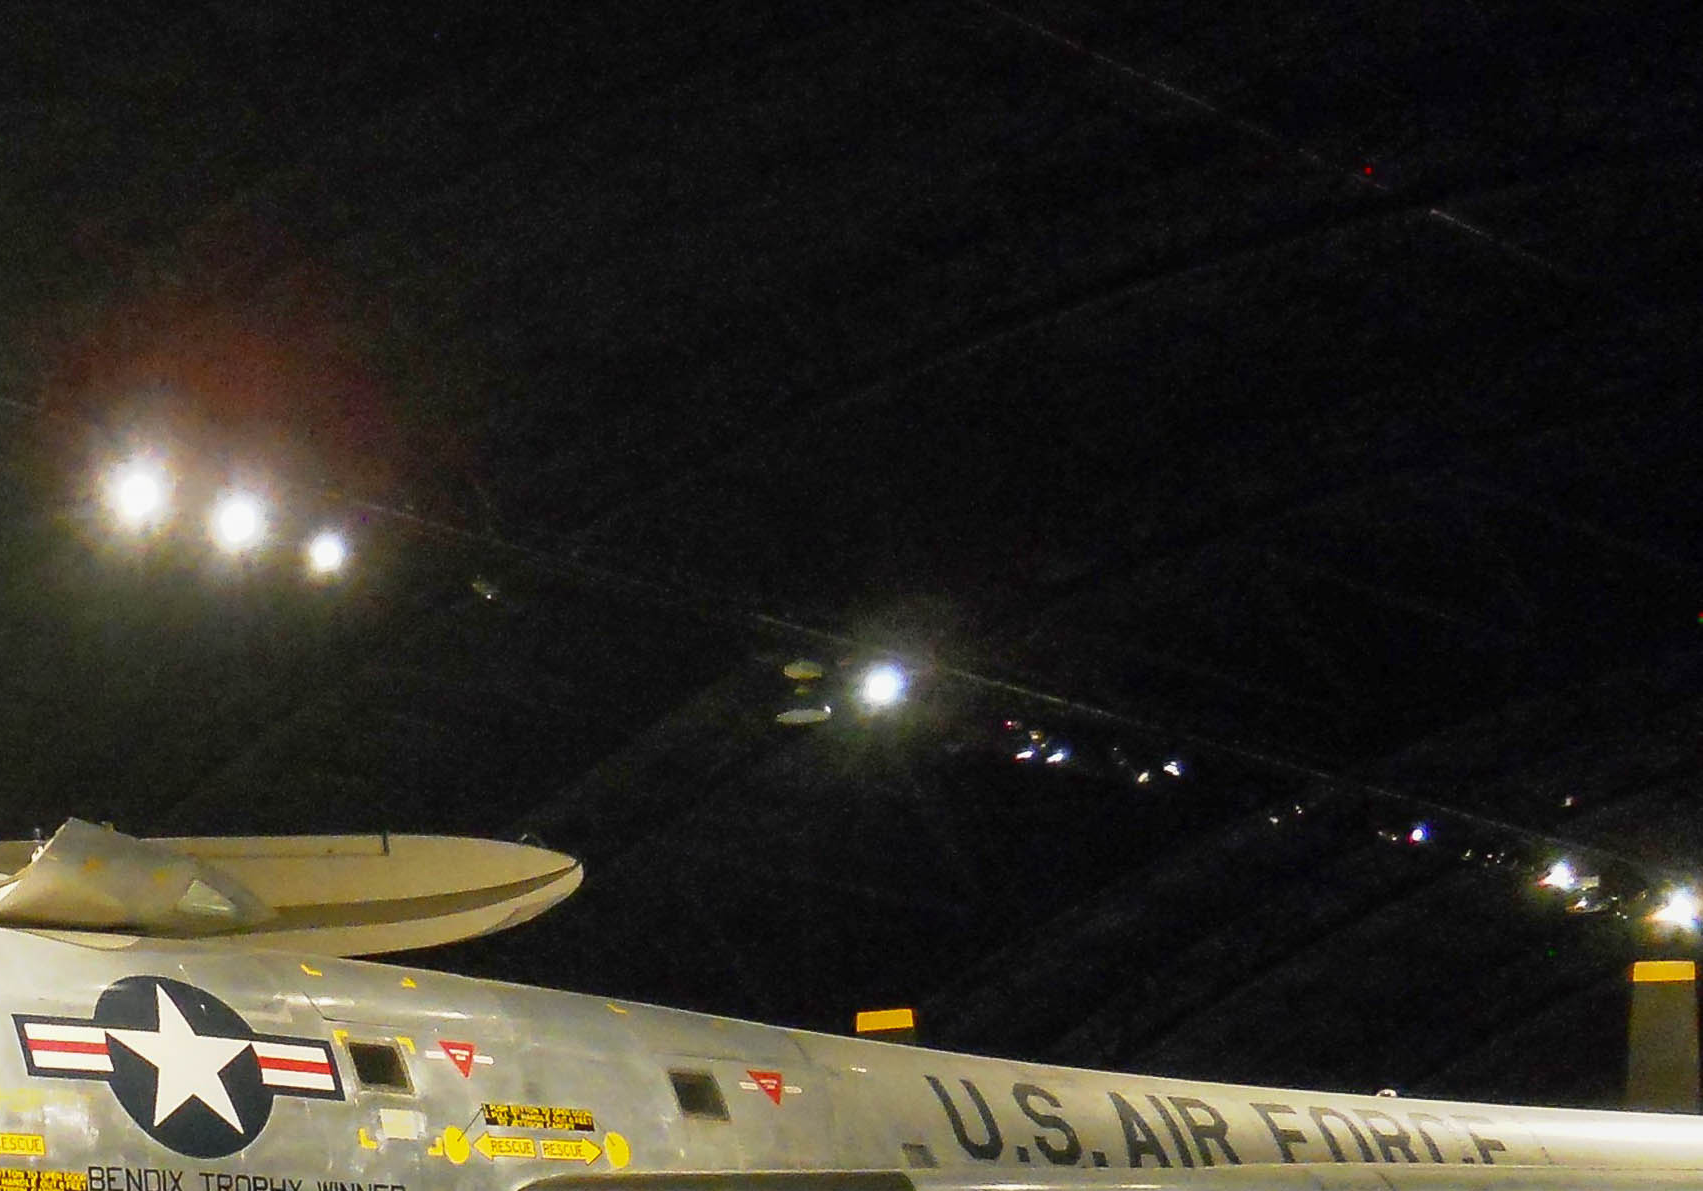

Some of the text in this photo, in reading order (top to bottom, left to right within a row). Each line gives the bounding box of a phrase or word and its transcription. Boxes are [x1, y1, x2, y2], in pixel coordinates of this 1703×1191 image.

[1108, 1091, 1243, 1168] AIR
[491, 1140, 534, 1155] RESCUE
[543, 1142, 585, 1158] RESCUE
